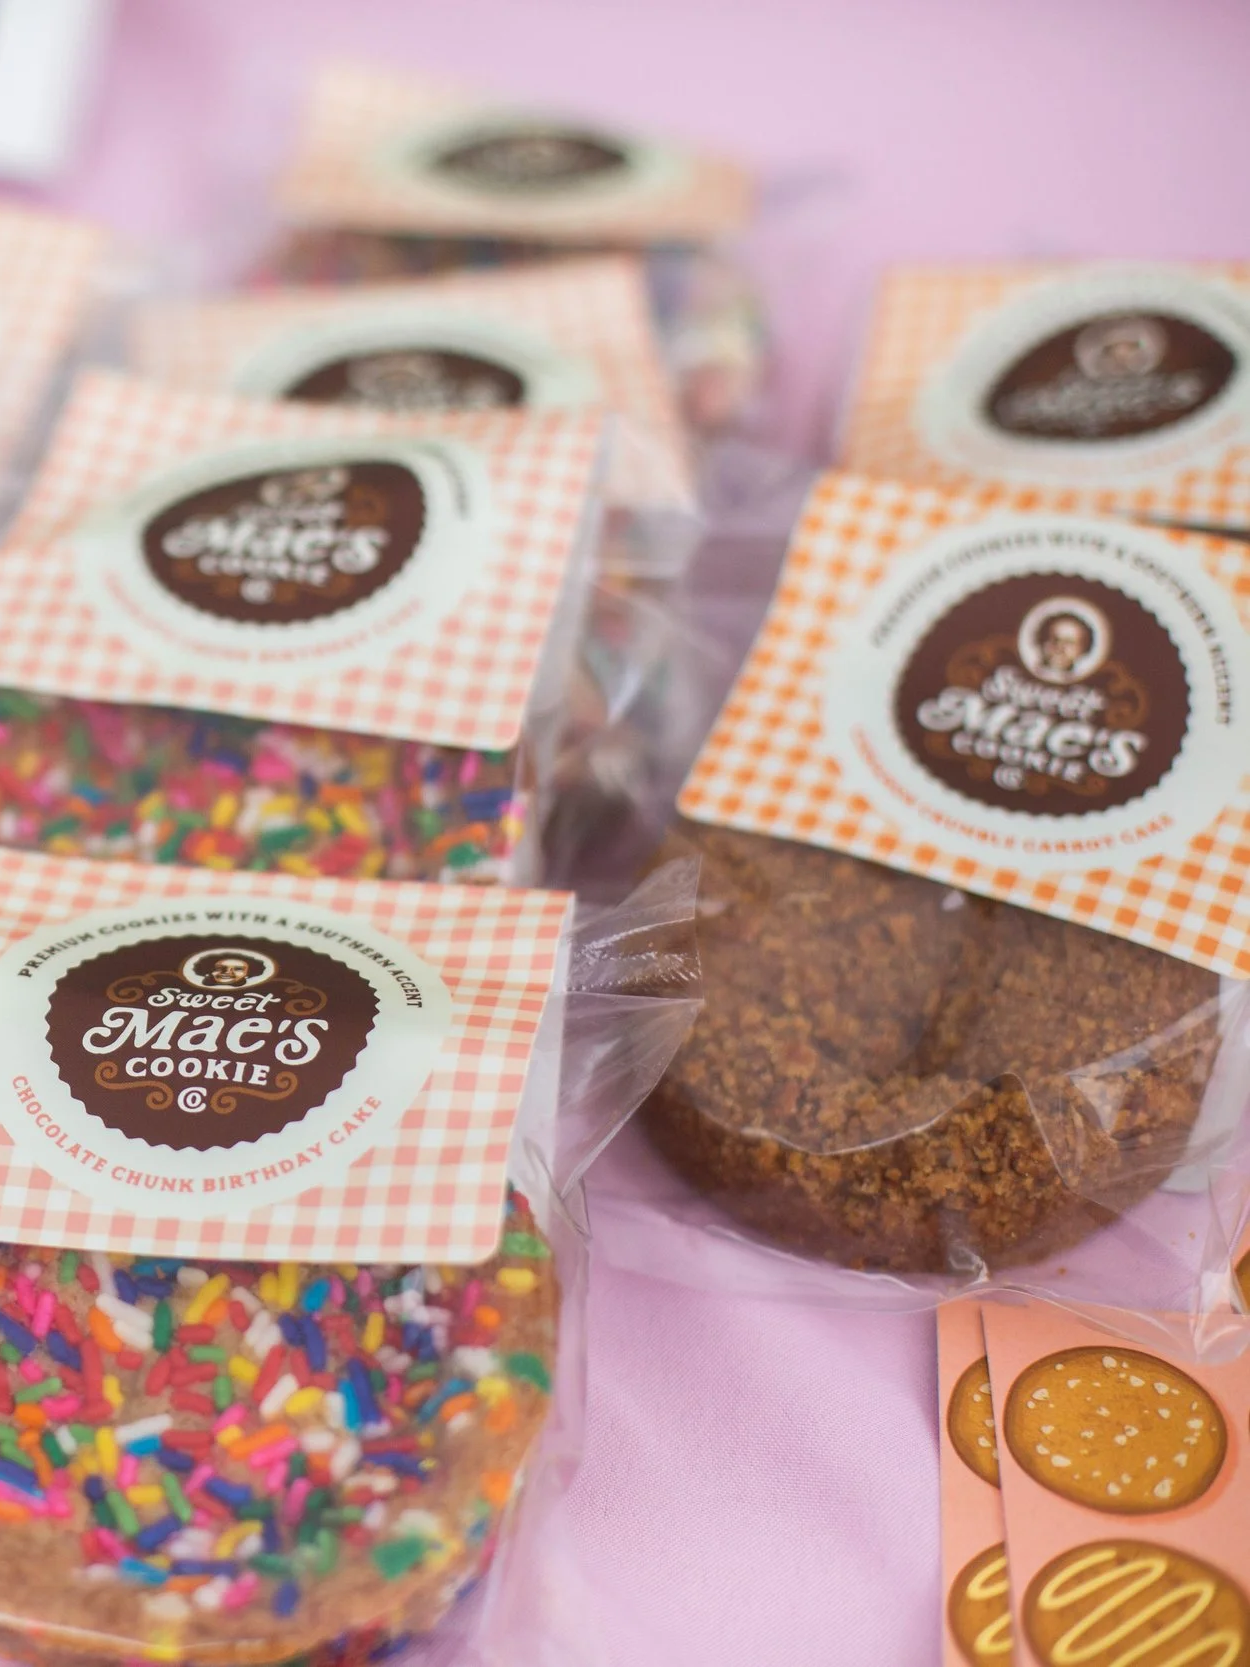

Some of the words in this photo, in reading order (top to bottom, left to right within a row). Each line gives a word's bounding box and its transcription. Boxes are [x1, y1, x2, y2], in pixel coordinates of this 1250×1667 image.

[17, 930, 94, 979] PREMIUM
[98, 911, 197, 937] COOKIES
[206, 911, 267, 926] WITH
[276, 917, 290, 929] A
[295, 922, 392, 968] SOUTHERN
[388, 967, 423, 1009] ACCENT
[147, 987, 281, 1013] Sweet
[125, 1057, 270, 1087] COOKIE
[12, 1075, 106, 1173] CHOCOLATE
[111, 1165, 194, 1193] CHUNK
[202, 1142, 324, 1193] BIRTHDAY
[327, 1095, 382, 1145] CAKE
